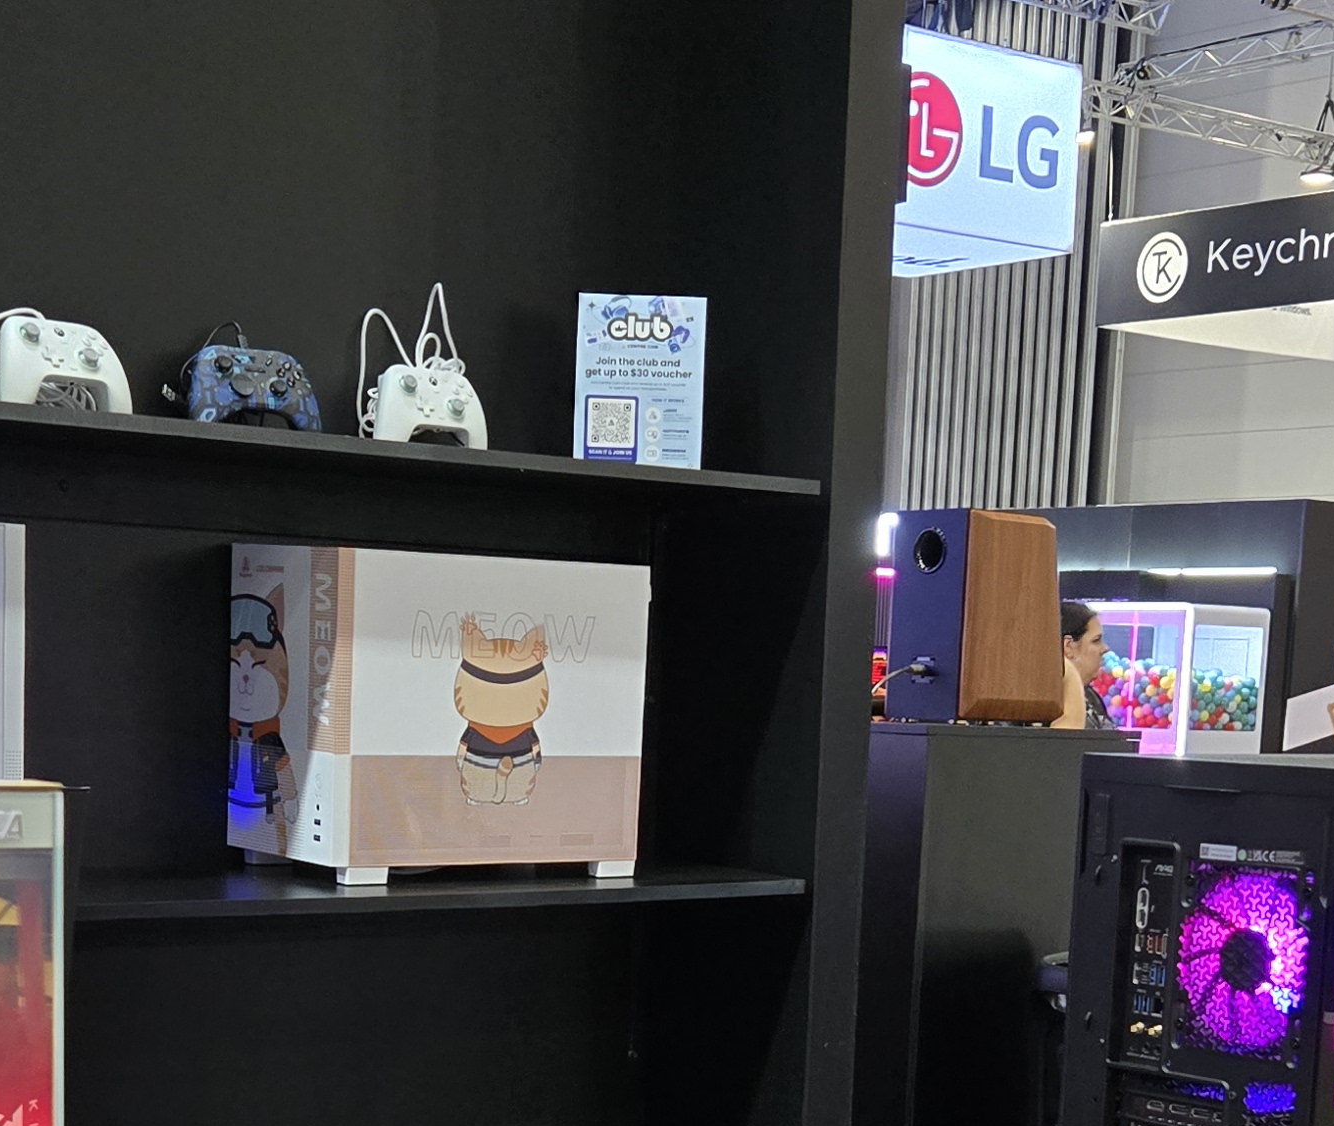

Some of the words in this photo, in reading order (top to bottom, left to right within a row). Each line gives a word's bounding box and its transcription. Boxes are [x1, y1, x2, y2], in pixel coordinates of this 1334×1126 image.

[978, 103, 1061, 190] LG
[609, 314, 672, 340] club
[585, 368, 603, 379] get
[604, 369, 617, 379] up
[618, 369, 629, 377] to
[630, 368, 649, 378] $30
[651, 369, 693, 379] voucher
[595, 356, 617, 366] Join
[617, 357, 635, 366] the
[636, 357, 659, 367] club
[660, 358, 681, 368] and
[312, 571, 335, 727] MEOW
[411, 608, 596, 664] MEOW
